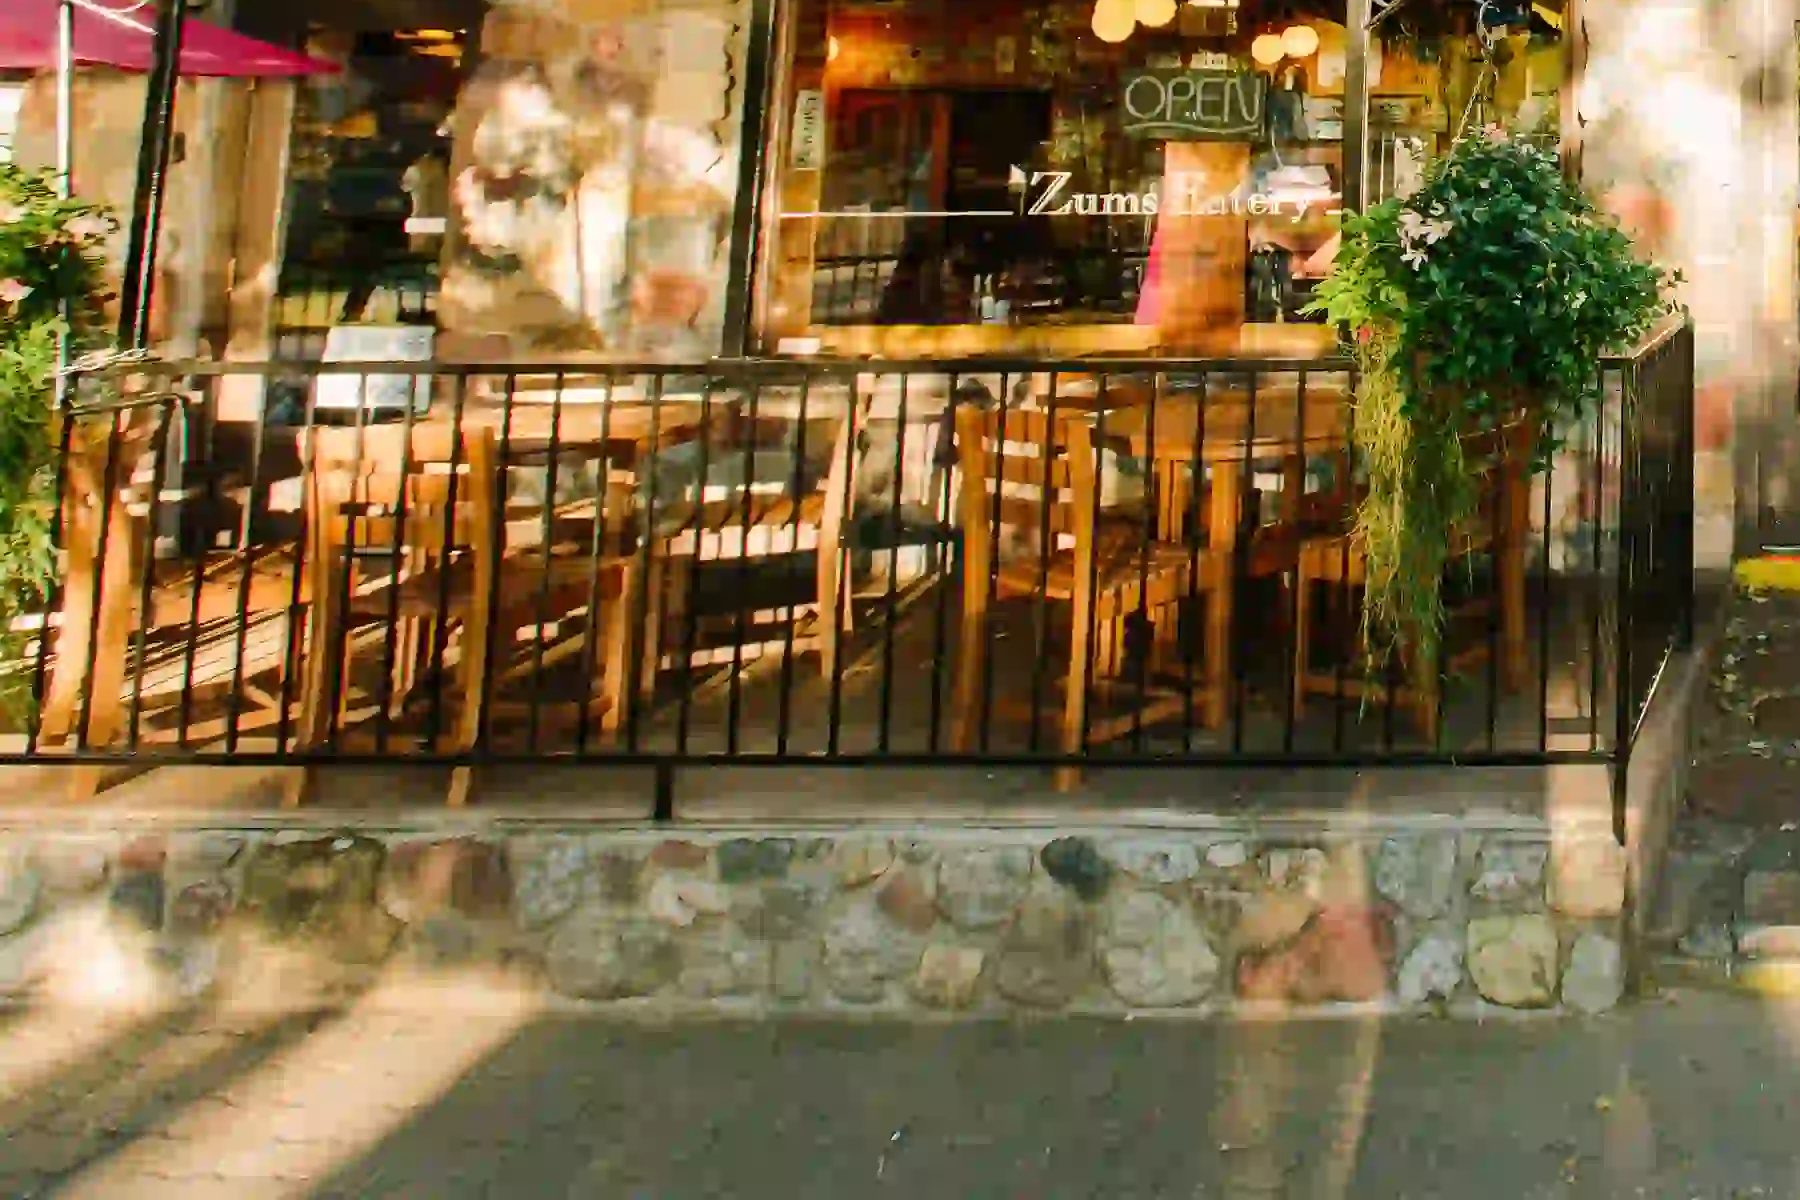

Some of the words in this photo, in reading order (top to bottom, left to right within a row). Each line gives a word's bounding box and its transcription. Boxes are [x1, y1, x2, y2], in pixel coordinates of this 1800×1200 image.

[1125, 75, 1262, 123] OPEN
[1028, 171, 1159, 216] Zums
[1174, 171, 1316, 223] Eatery
